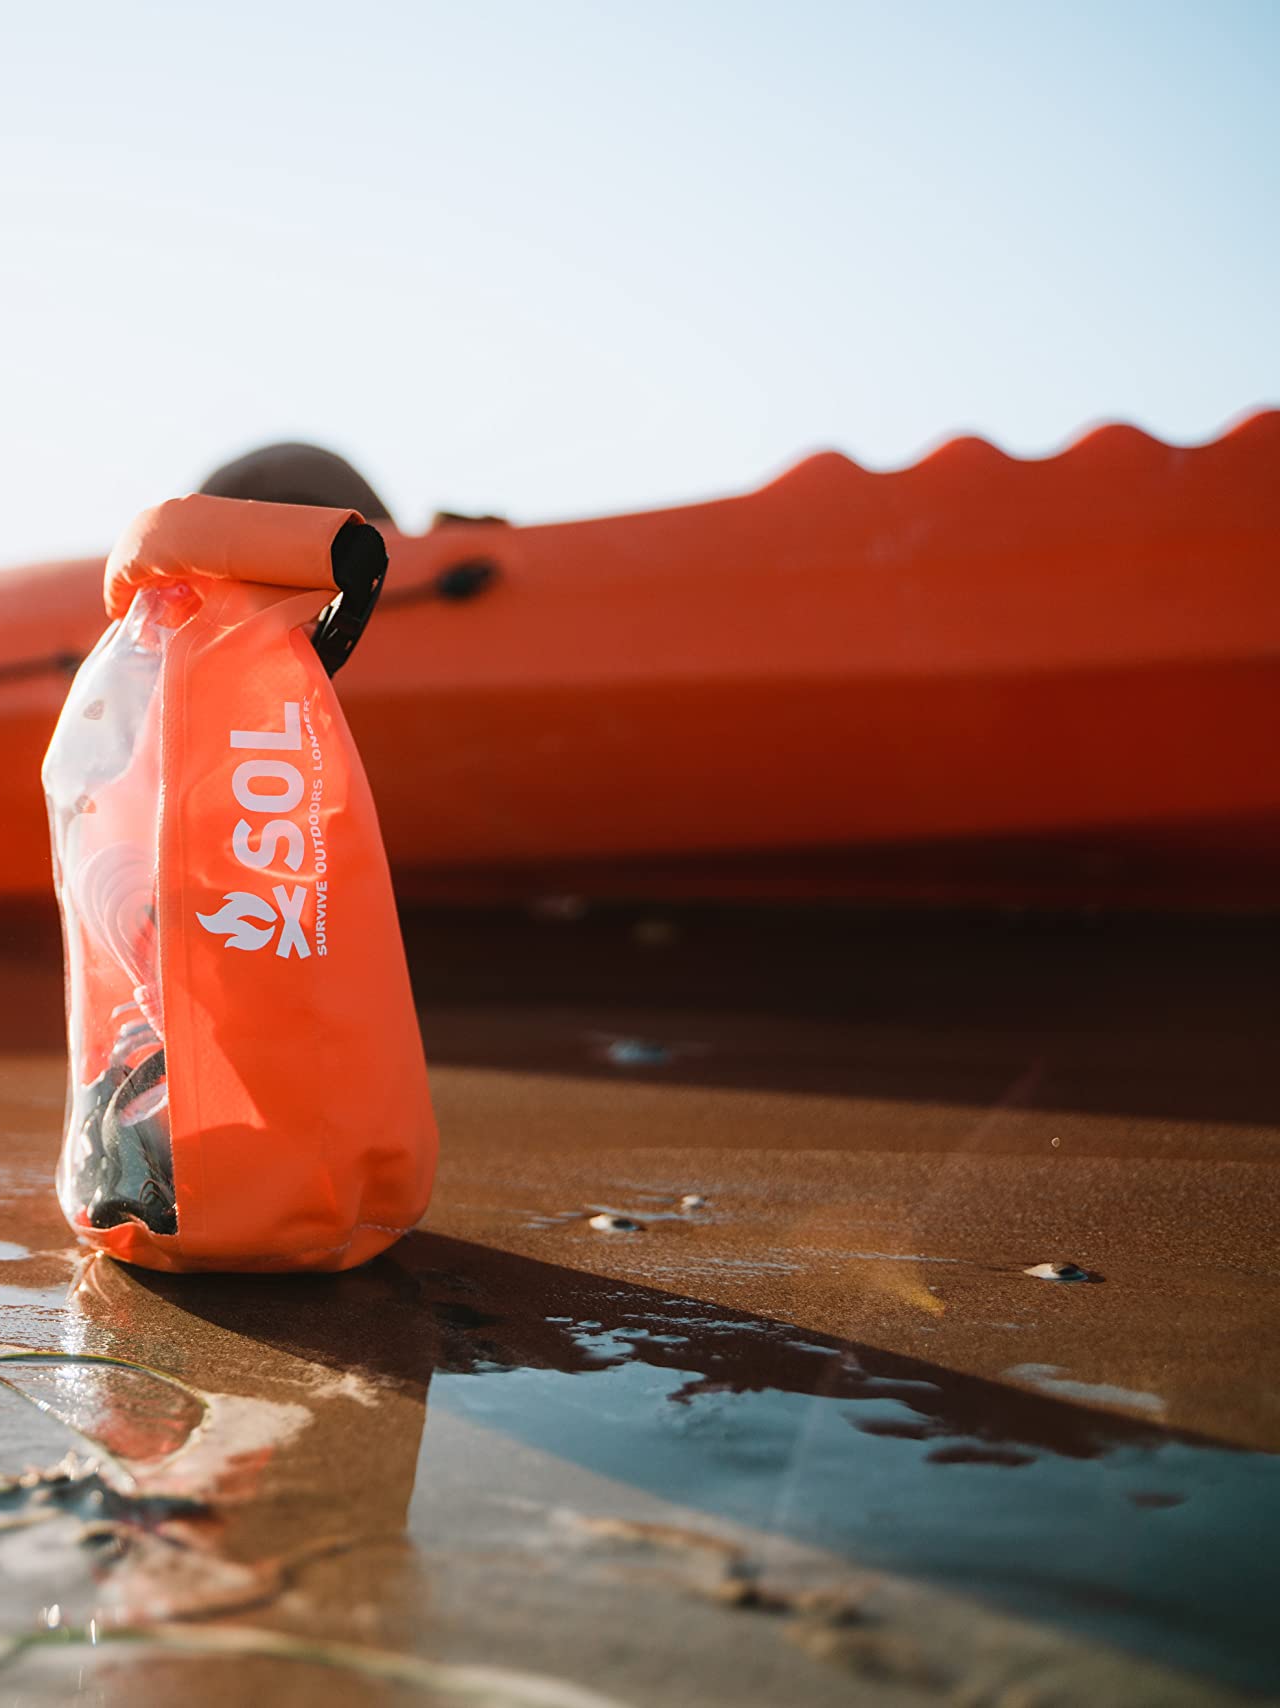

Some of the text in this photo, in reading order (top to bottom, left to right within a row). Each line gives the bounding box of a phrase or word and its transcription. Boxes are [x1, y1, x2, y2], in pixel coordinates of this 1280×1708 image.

[230, 701, 305, 872] SOL
[308, 779, 328, 874] OUTDOORS
[315, 881, 328, 956] SURVIVE
